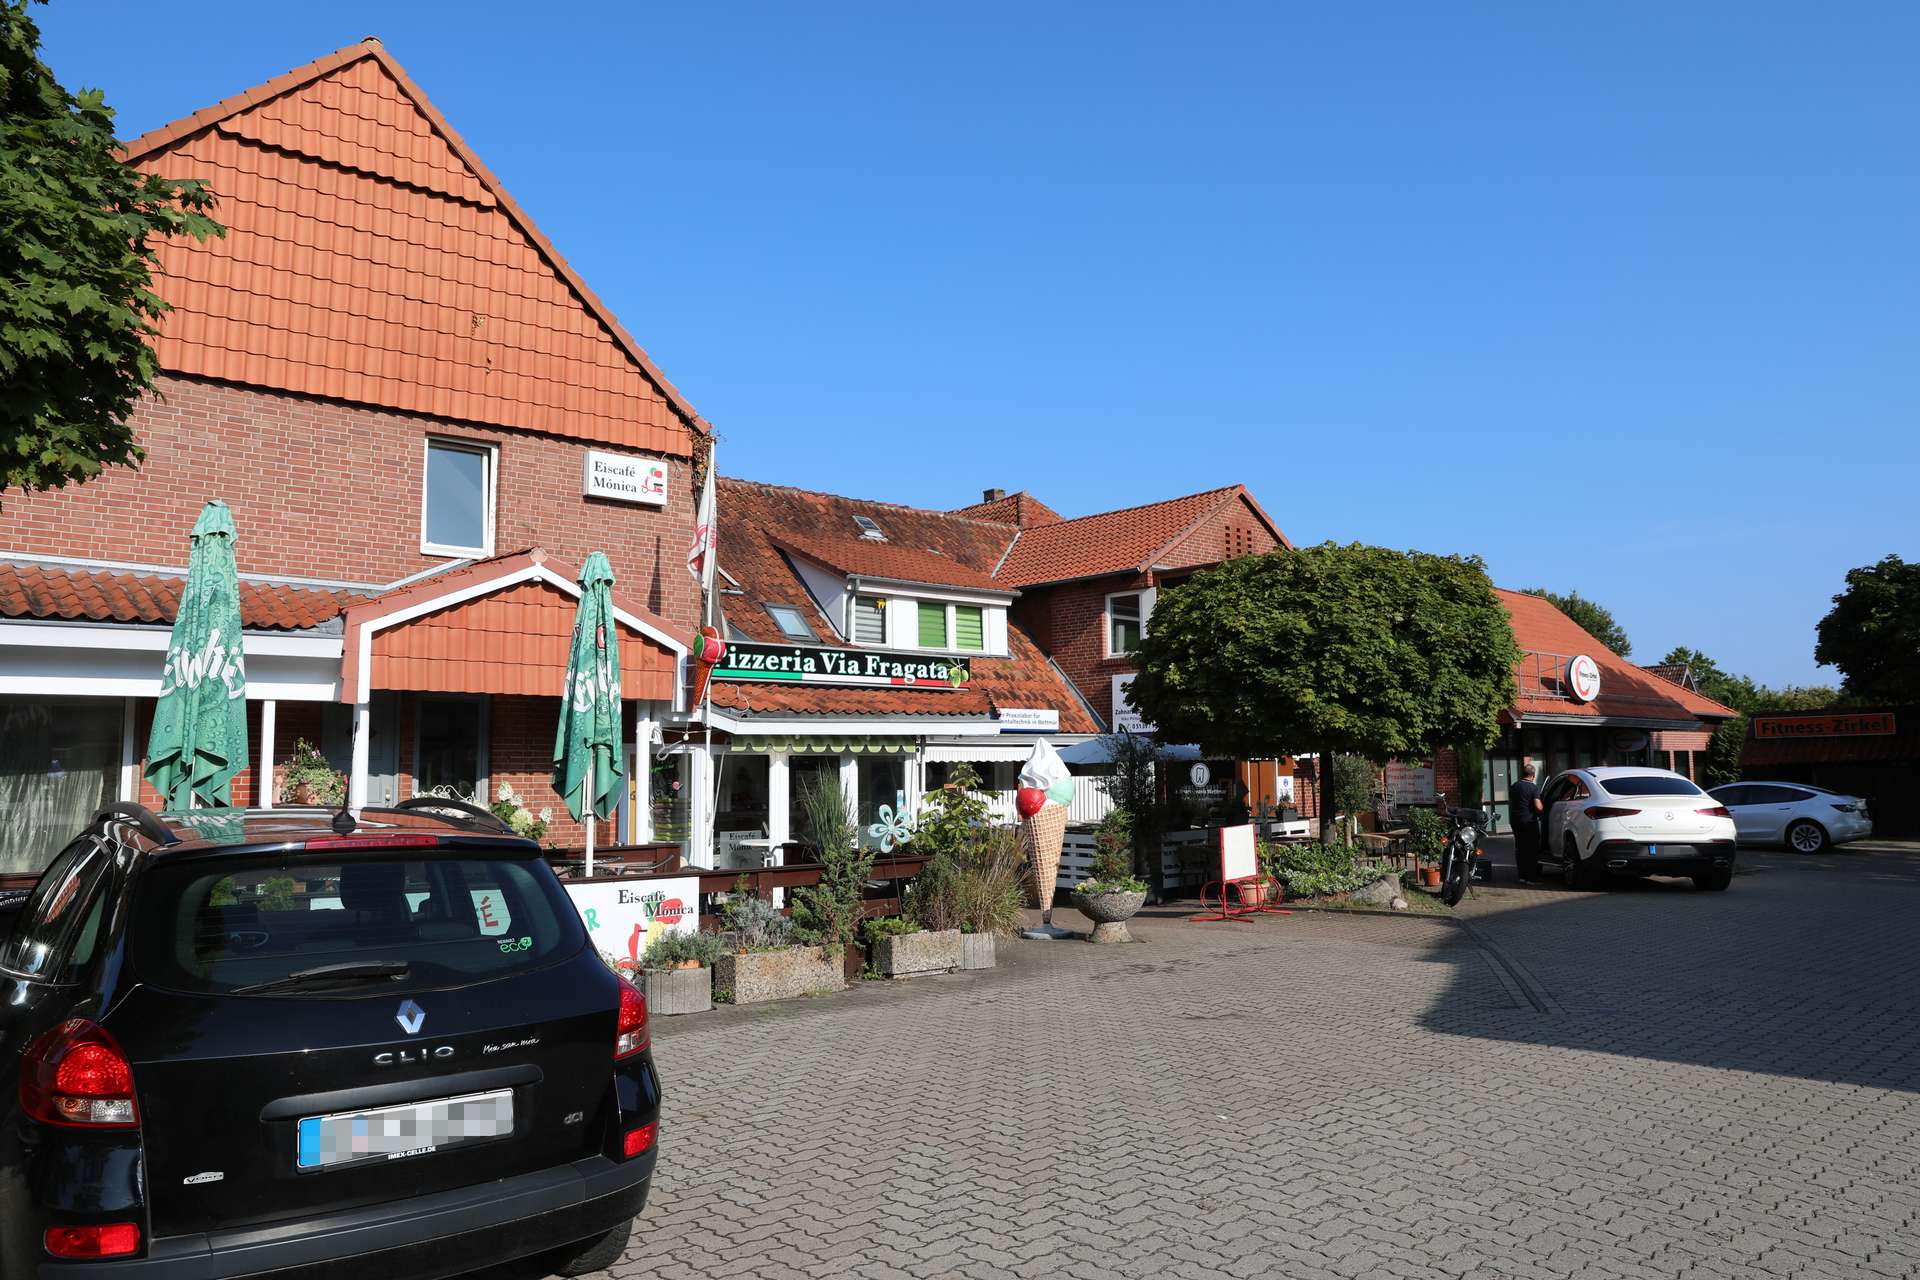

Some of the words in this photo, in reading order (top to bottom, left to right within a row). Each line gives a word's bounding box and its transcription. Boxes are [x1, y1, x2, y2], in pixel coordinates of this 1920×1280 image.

[594, 461, 636, 477] Eiscafé
[593, 476, 637, 493] Mónica
[820, 652, 860, 675] Via
[865, 655, 949, 683] Fragata
[618, 889, 666, 905] Eiscafé
[645, 902, 694, 918] Mónica
[374, 1046, 455, 1065] CLIO
[388, 1146, 437, 1160] IMEX-CELLE.DE
